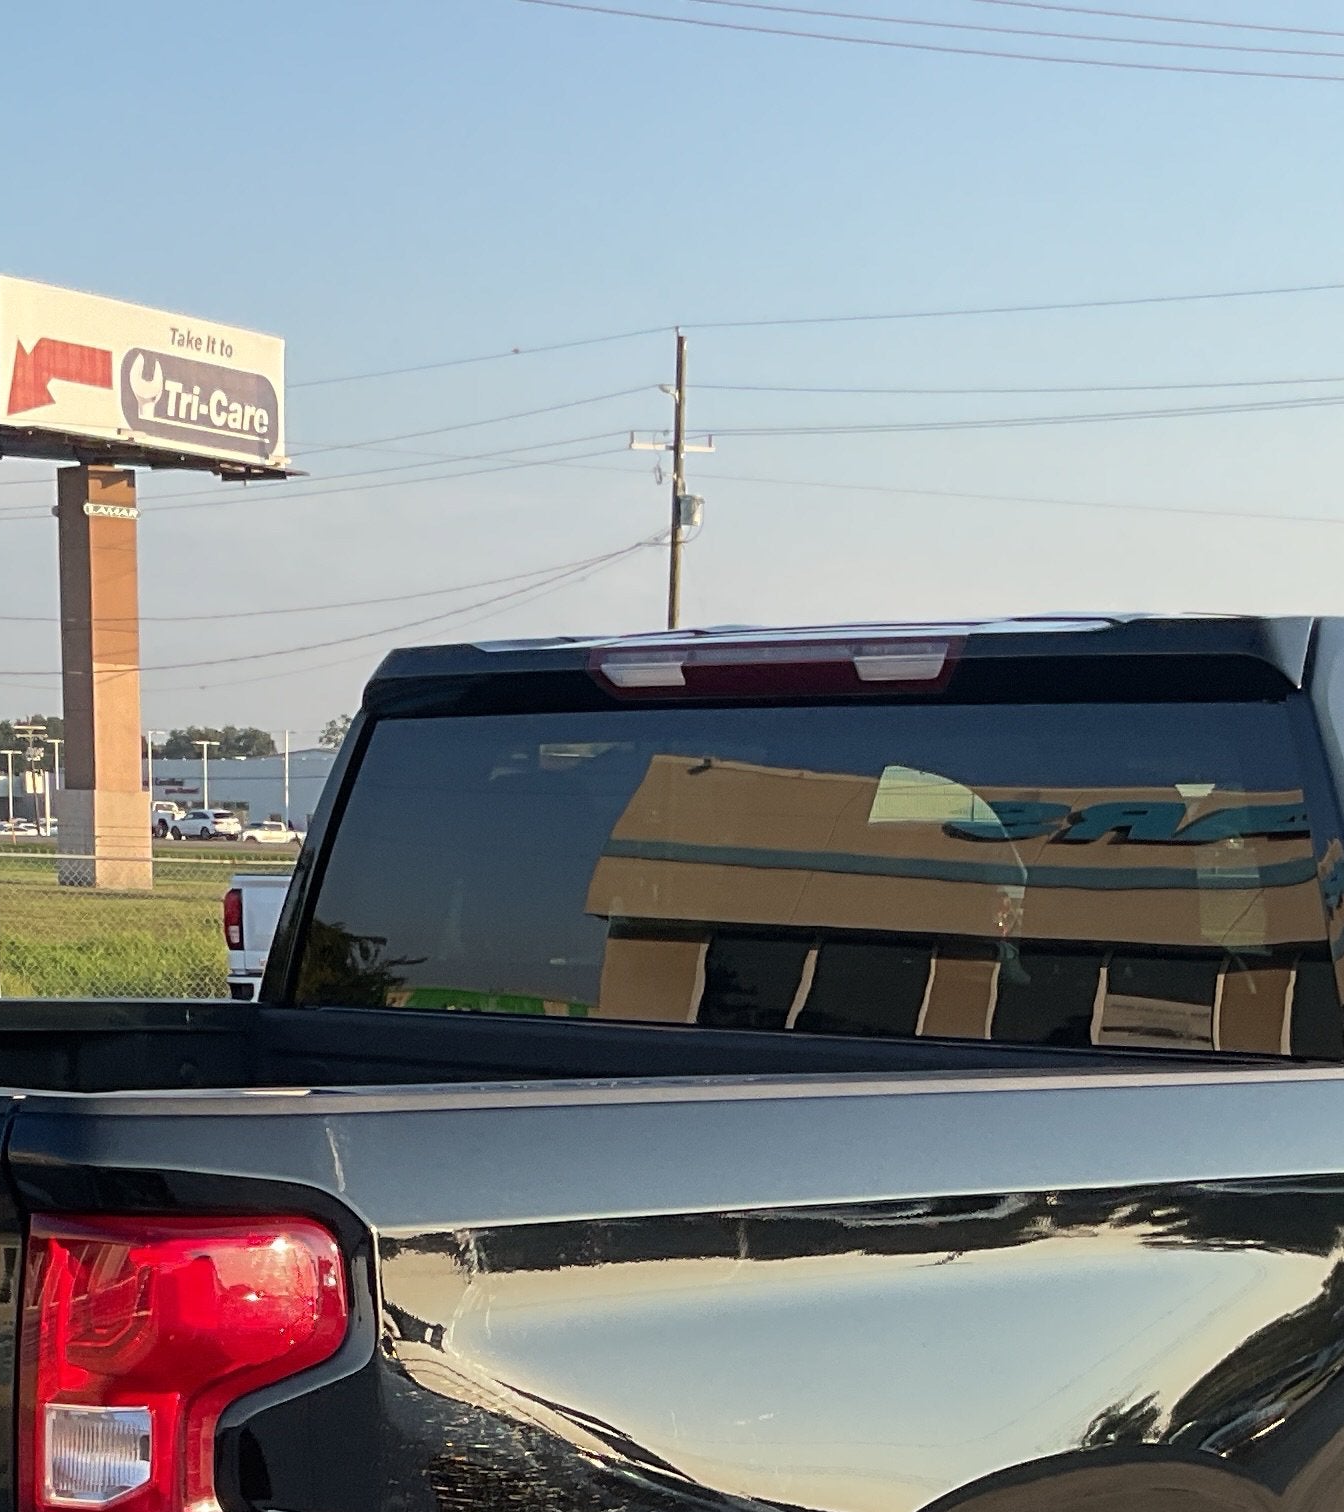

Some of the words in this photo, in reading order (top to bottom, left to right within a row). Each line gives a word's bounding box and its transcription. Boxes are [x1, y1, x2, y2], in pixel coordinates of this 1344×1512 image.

[170, 327, 202, 351] Take
[206, 335, 215, 354] It
[220, 340, 233, 358] to
[164, 379, 269, 434] Tri-Care
[85, 504, 138, 519] LAMAR
